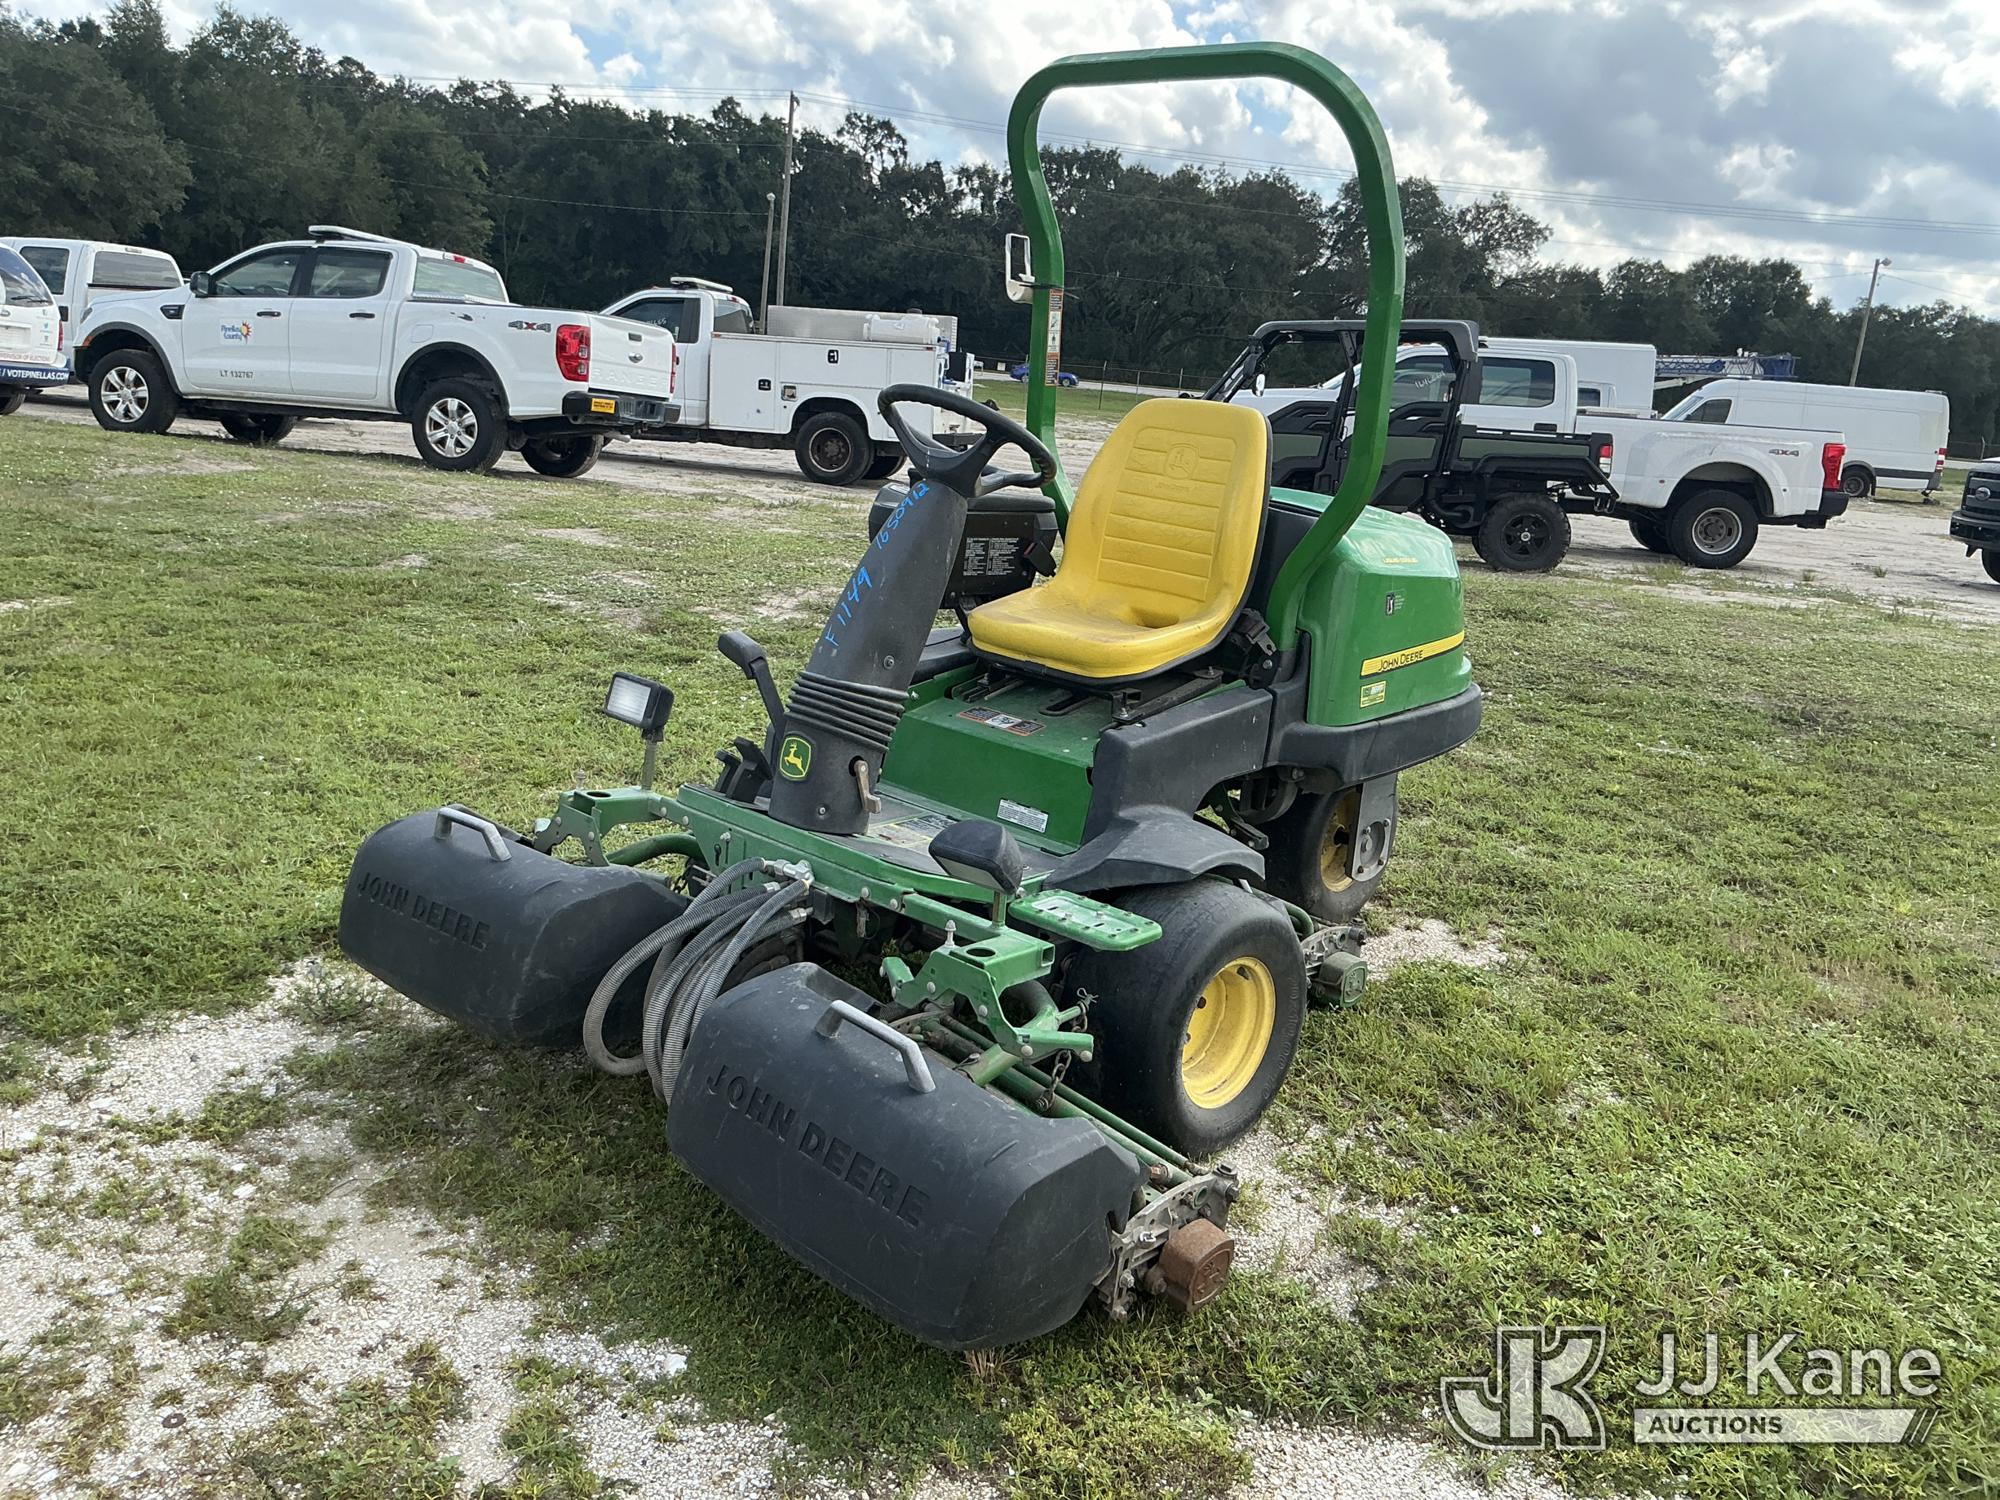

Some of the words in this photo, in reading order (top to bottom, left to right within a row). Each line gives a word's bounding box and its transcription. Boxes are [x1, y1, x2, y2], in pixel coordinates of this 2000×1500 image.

[1378, 658, 1400, 672] JOHN
[1400, 650, 1424, 665] DEERE
[358, 872, 409, 916] JOHN
[410, 895, 491, 951] DEERE
[706, 1064, 796, 1142] JOHN
[798, 1121, 931, 1230] DEERE
